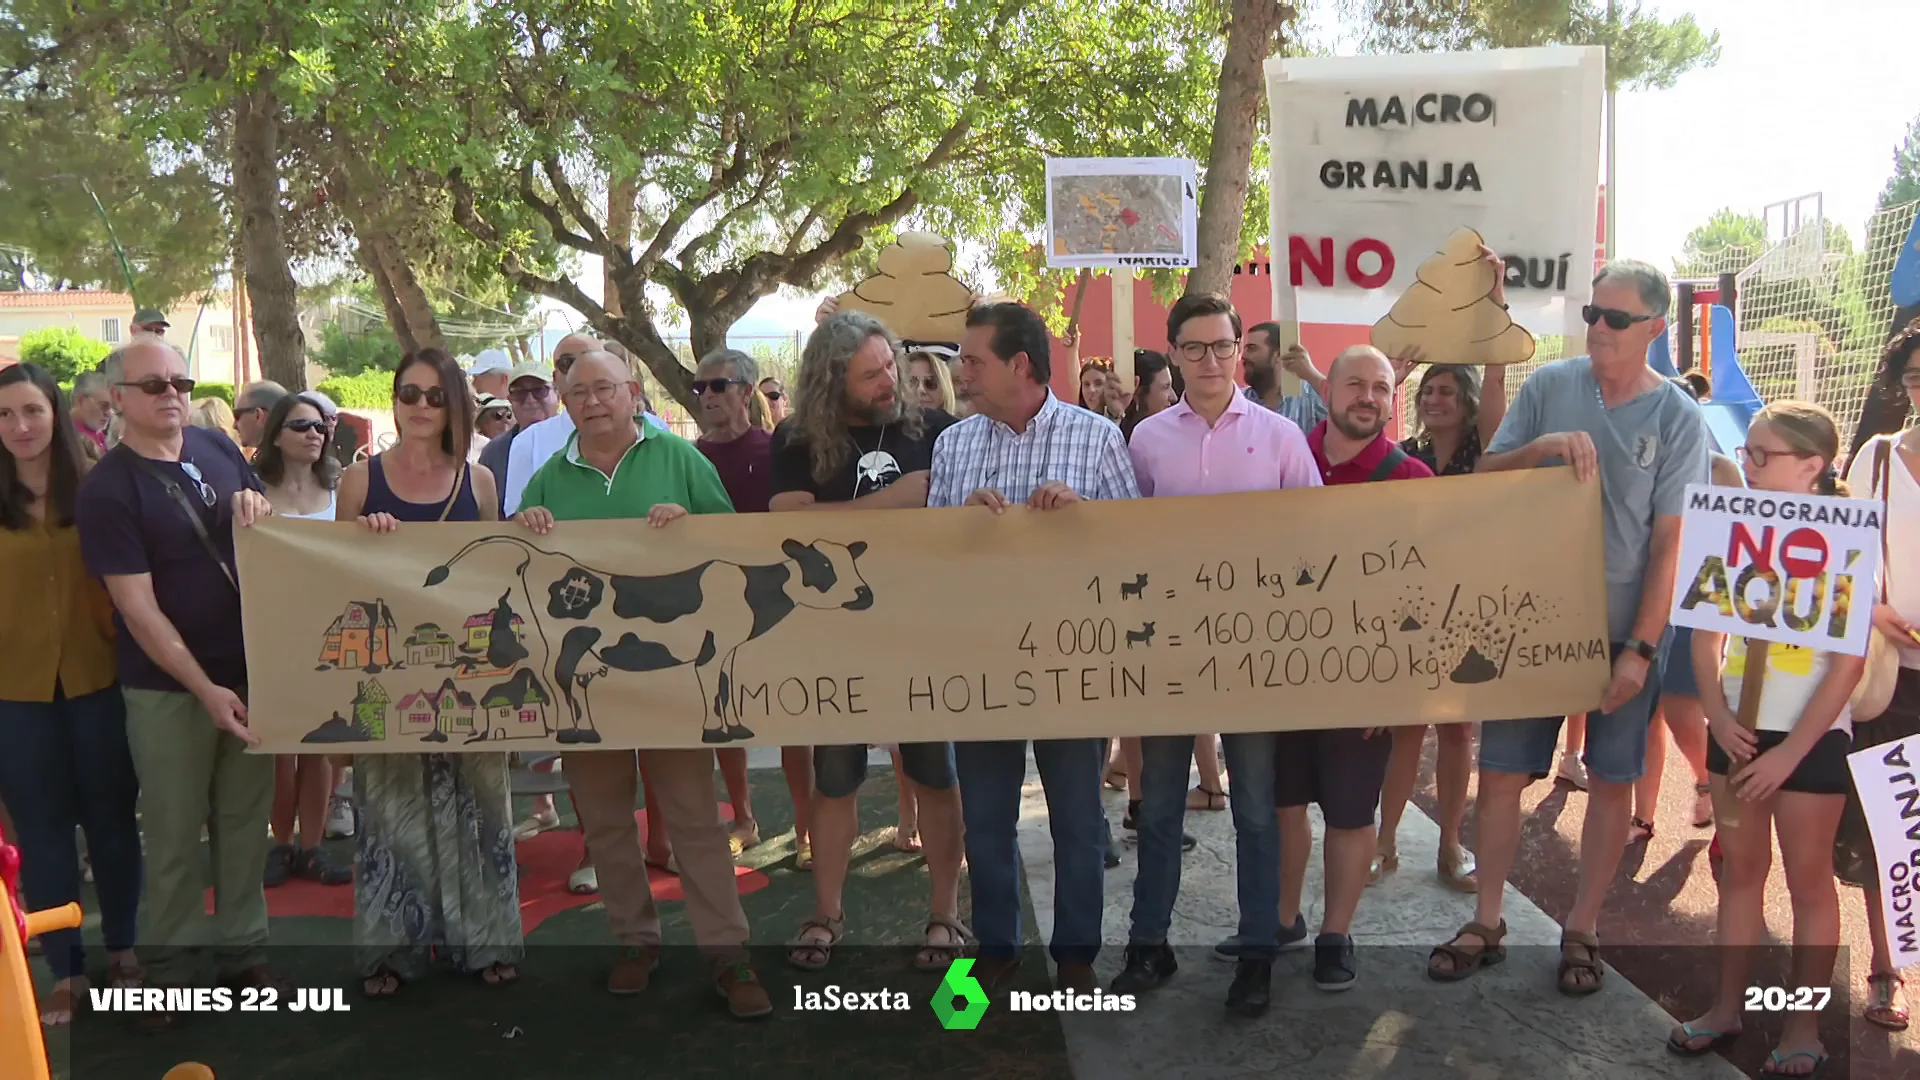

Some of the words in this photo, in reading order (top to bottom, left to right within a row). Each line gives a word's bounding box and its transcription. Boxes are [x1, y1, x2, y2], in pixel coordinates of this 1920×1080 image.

[1345, 92, 1496, 127] MACRO
[1319, 159, 1482, 192] GRANJA
[1288, 234, 1396, 289] NO
[1503, 253, 1573, 291] QUÍ
[1689, 492, 1881, 530] MACROGRANJA
[1087, 576, 1101, 604] 1
[1195, 560, 1236, 592] 40
[1256, 557, 1285, 598] kg
[1362, 540, 1427, 577] DÍA
[1726, 521, 1829, 580] NO
[1194, 606, 1333, 646] 160.000
[1352, 600, 1388, 648] kg
[1477, 584, 1537, 620] DÍA
[1679, 549, 1861, 640] AQUÍ
[738, 675, 869, 718] MORE
[1409, 644, 1441, 690] kg
[1888, 860, 1919, 954] MACRO
